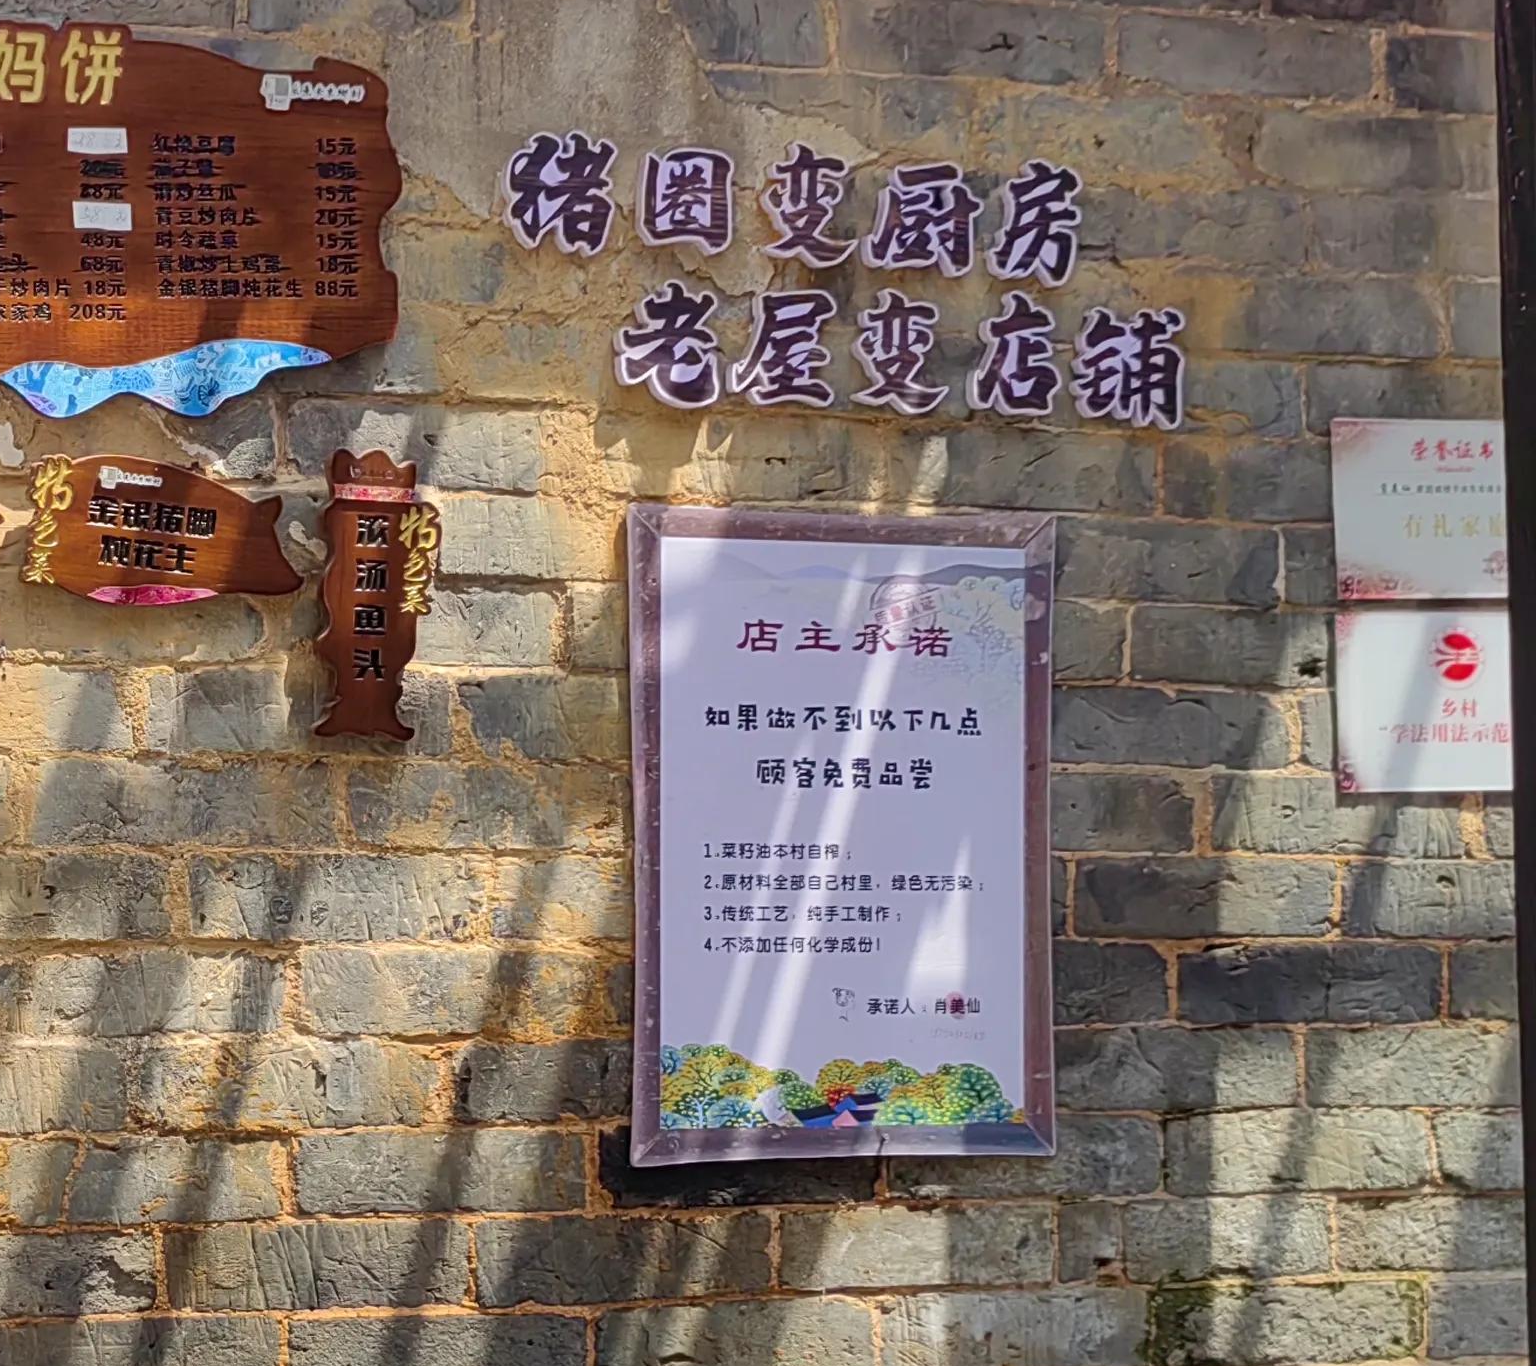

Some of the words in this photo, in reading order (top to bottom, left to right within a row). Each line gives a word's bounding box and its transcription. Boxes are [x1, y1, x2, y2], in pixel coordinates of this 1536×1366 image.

[316, 138, 357, 155] 15元
[506, 132, 1081, 288] 猪圈变厨房
[84, 278, 128, 297] 18元
[315, 279, 359, 298] 88元
[69, 303, 127, 321] 208元
[614, 279, 1186, 431] 老屋变店铺
[24, 458, 73, 584] 特色菜
[399, 507, 438, 614] 特色菜
[736, 619, 953, 657] 店主承诺
[704, 703, 982, 737] 如果做不到以下几点
[1442, 698, 1477, 717] 乡村
[756, 757, 933, 790] 顾客免费品尝
